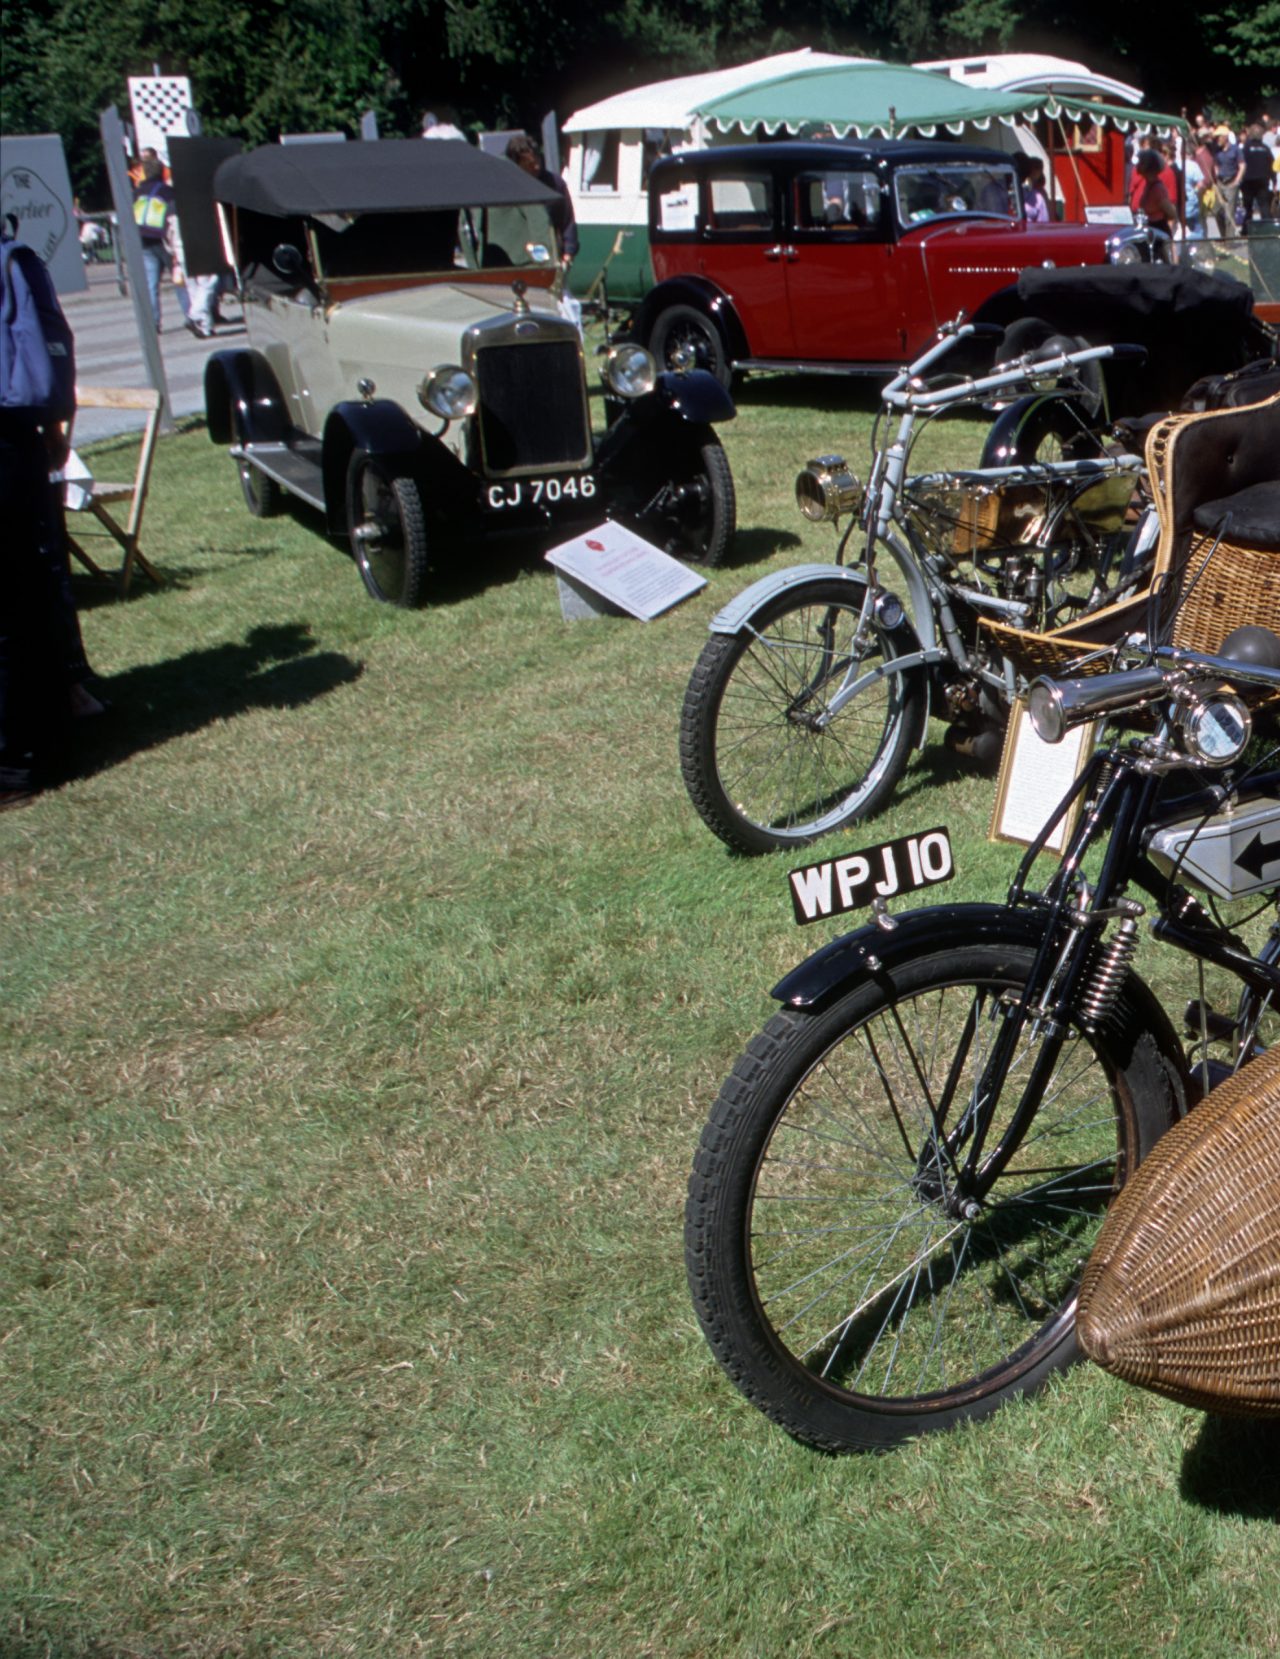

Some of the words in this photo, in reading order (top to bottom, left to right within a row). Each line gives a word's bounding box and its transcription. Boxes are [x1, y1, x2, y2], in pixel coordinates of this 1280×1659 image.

[488, 482, 522, 508] CJ
[530, 475, 596, 503] 7046
[791, 846, 898, 919] WPJ
[907, 832, 951, 886] 10
